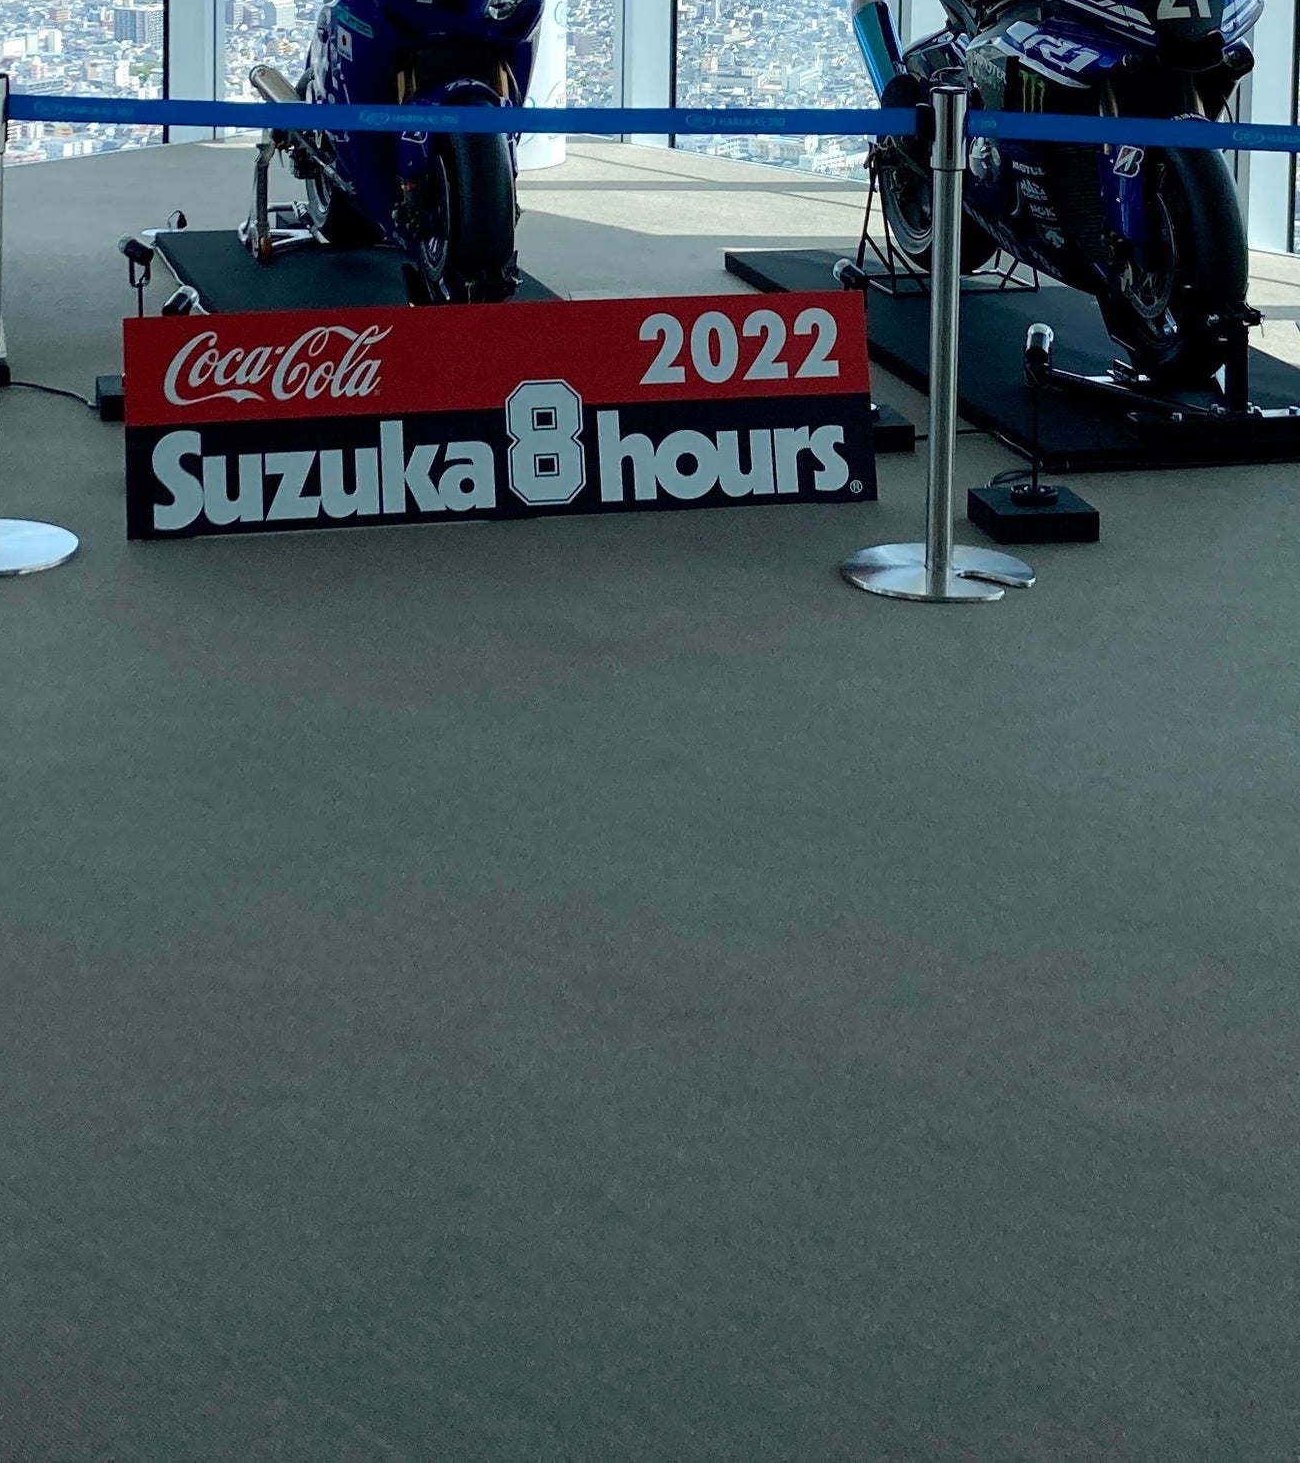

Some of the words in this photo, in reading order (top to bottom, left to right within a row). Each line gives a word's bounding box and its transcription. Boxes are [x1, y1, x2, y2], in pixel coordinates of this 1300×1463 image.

[1012, 160, 1046, 176] MOTUL
[163, 325, 393, 406] Coca-Cola
[638, 307, 840, 386] 2022
[151, 420, 497, 530] Suzuka
[505, 378, 584, 506] 8
[596, 409, 850, 502] hours
